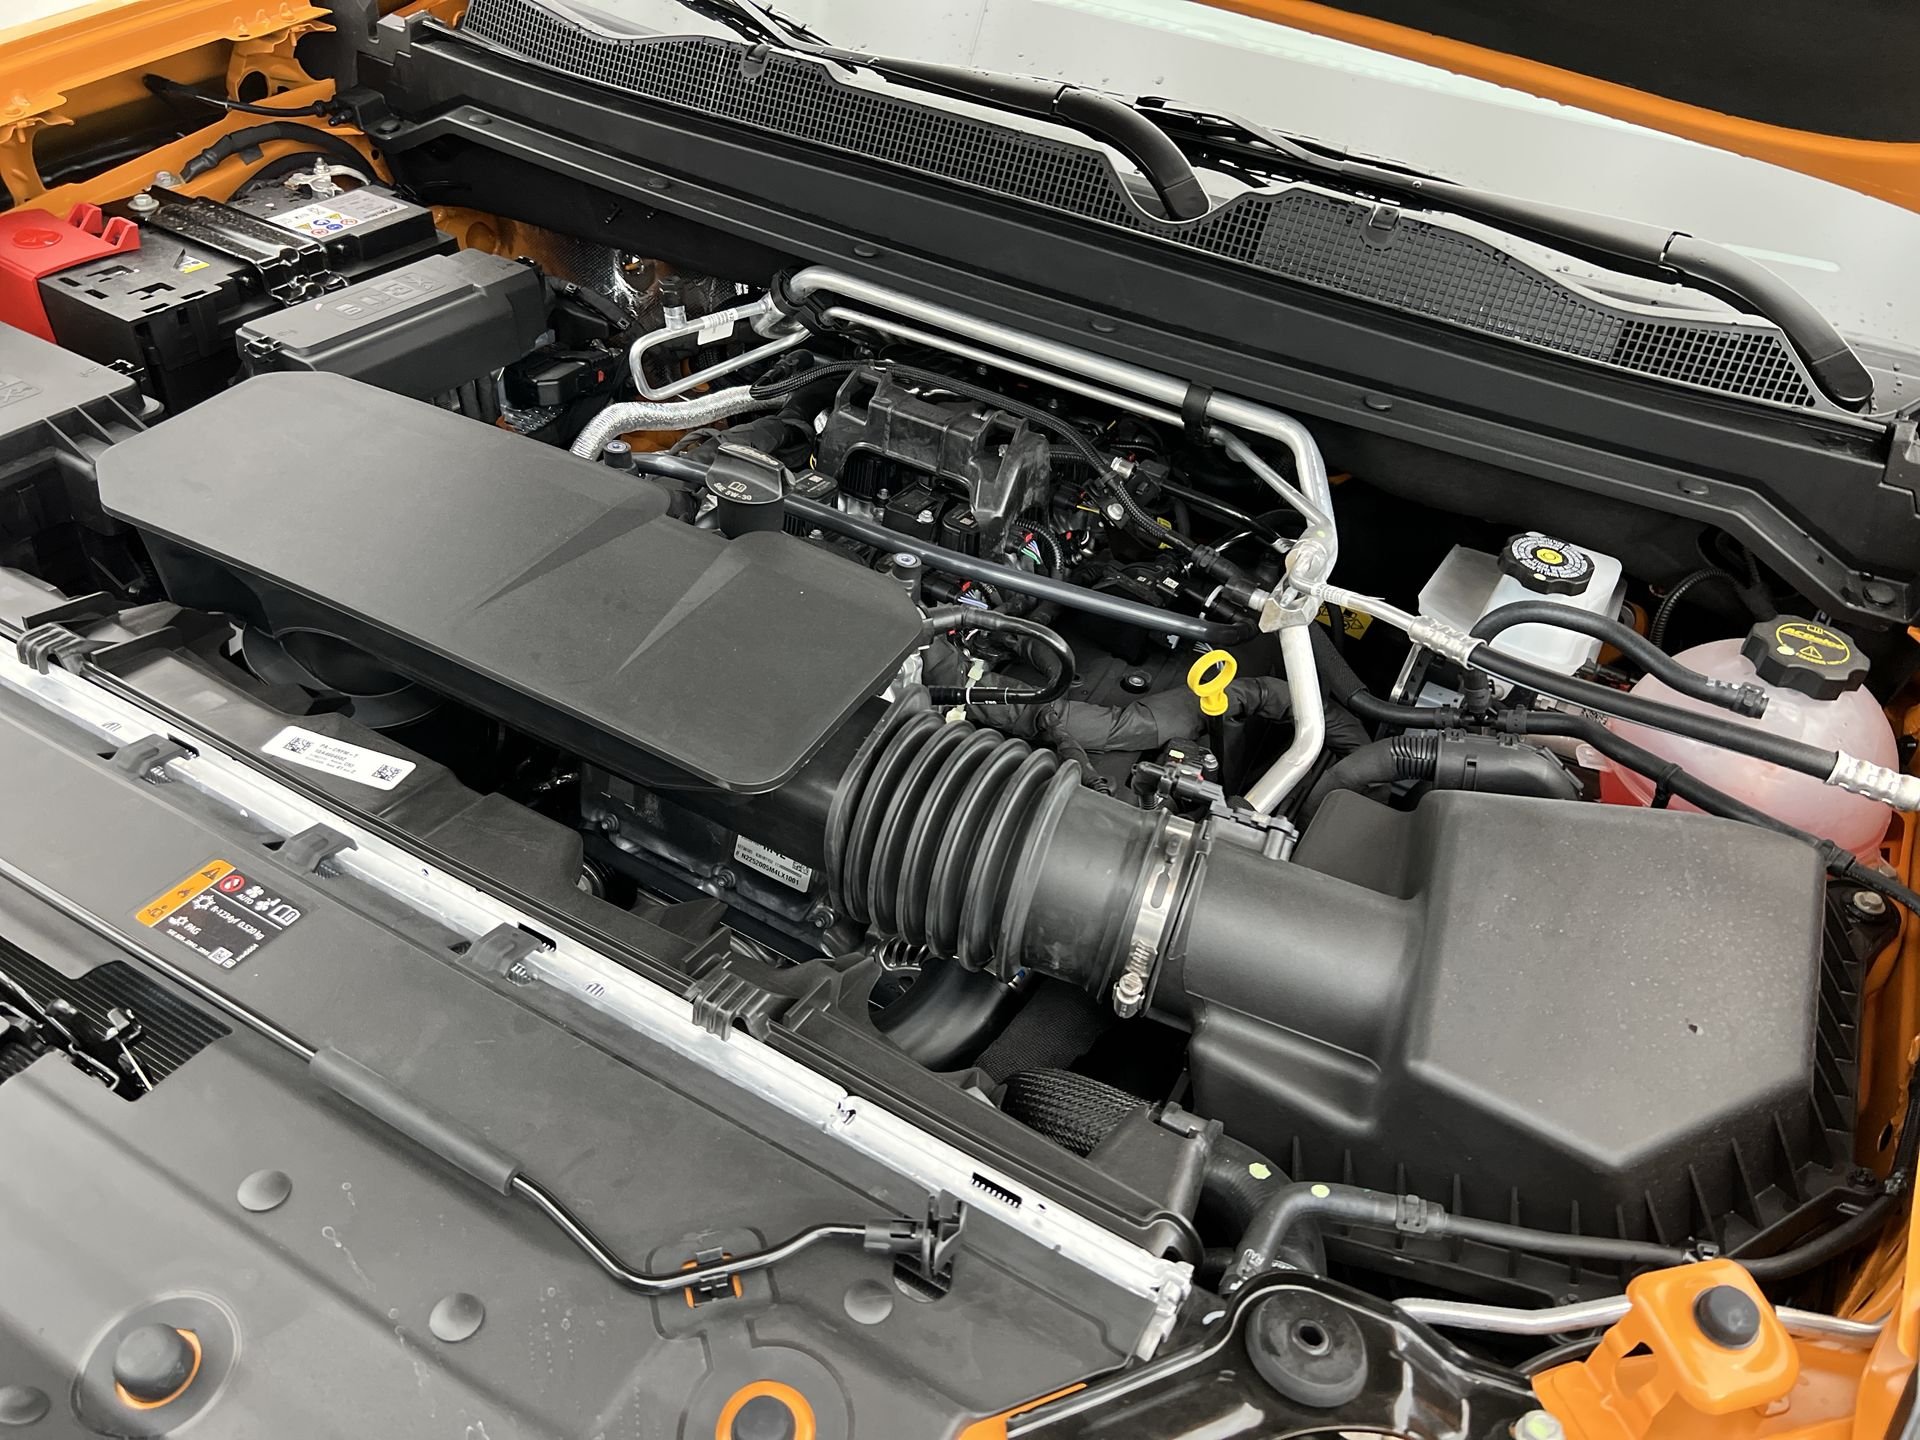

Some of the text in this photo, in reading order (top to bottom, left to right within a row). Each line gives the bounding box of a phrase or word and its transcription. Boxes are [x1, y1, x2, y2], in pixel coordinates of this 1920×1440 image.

[725, 490, 753, 501] 5W-30
[236, 893, 255, 905] AUTO
[184, 922, 201, 935] PAG
[238, 920, 257, 935] 0.520
[252, 929, 265, 941] kg
